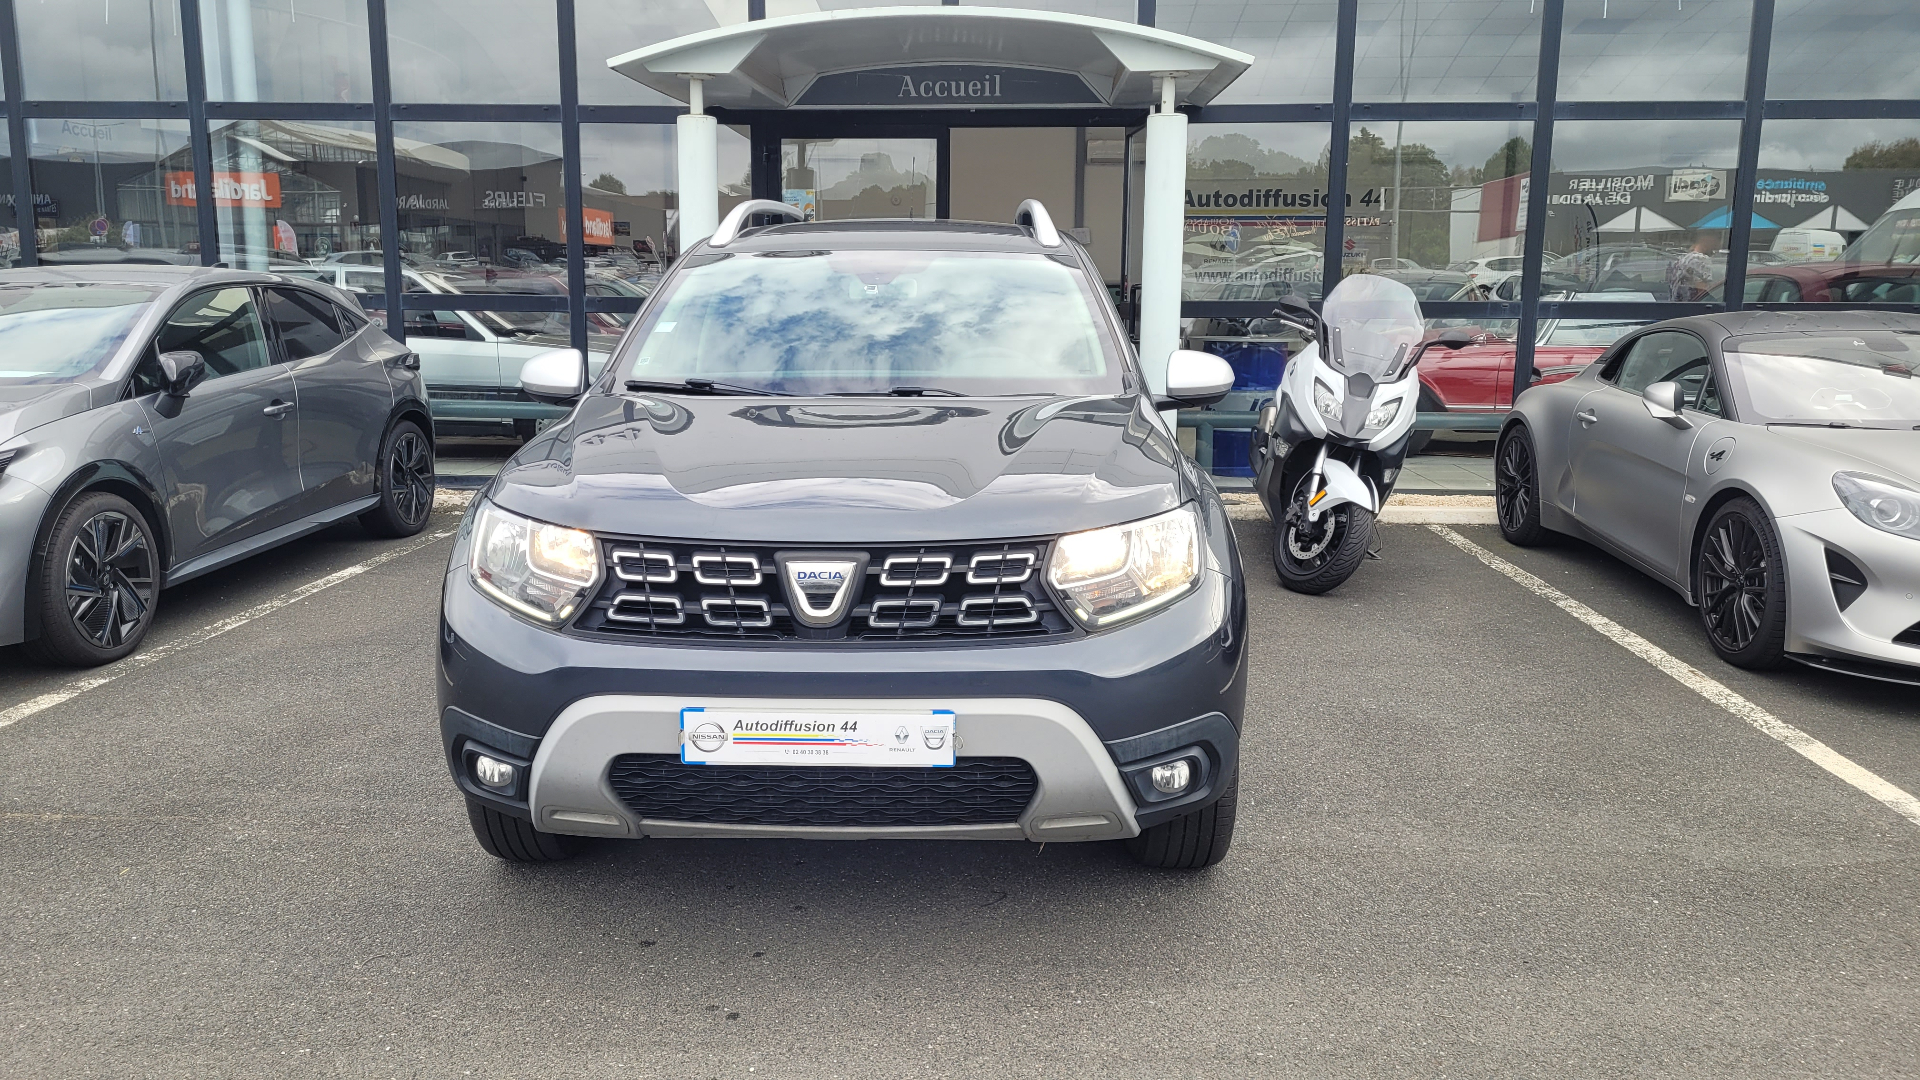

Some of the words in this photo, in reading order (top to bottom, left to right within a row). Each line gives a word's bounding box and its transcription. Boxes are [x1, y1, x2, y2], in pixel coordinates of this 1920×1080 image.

[897, 74, 1002, 97] Accueil
[61, 119, 112, 141] Accueil
[1360, 188, 1387, 206] 44
[797, 571, 843, 580] DACIA
[733, 719, 836, 733] Autodiffusion
[840, 720, 858, 733] 44
